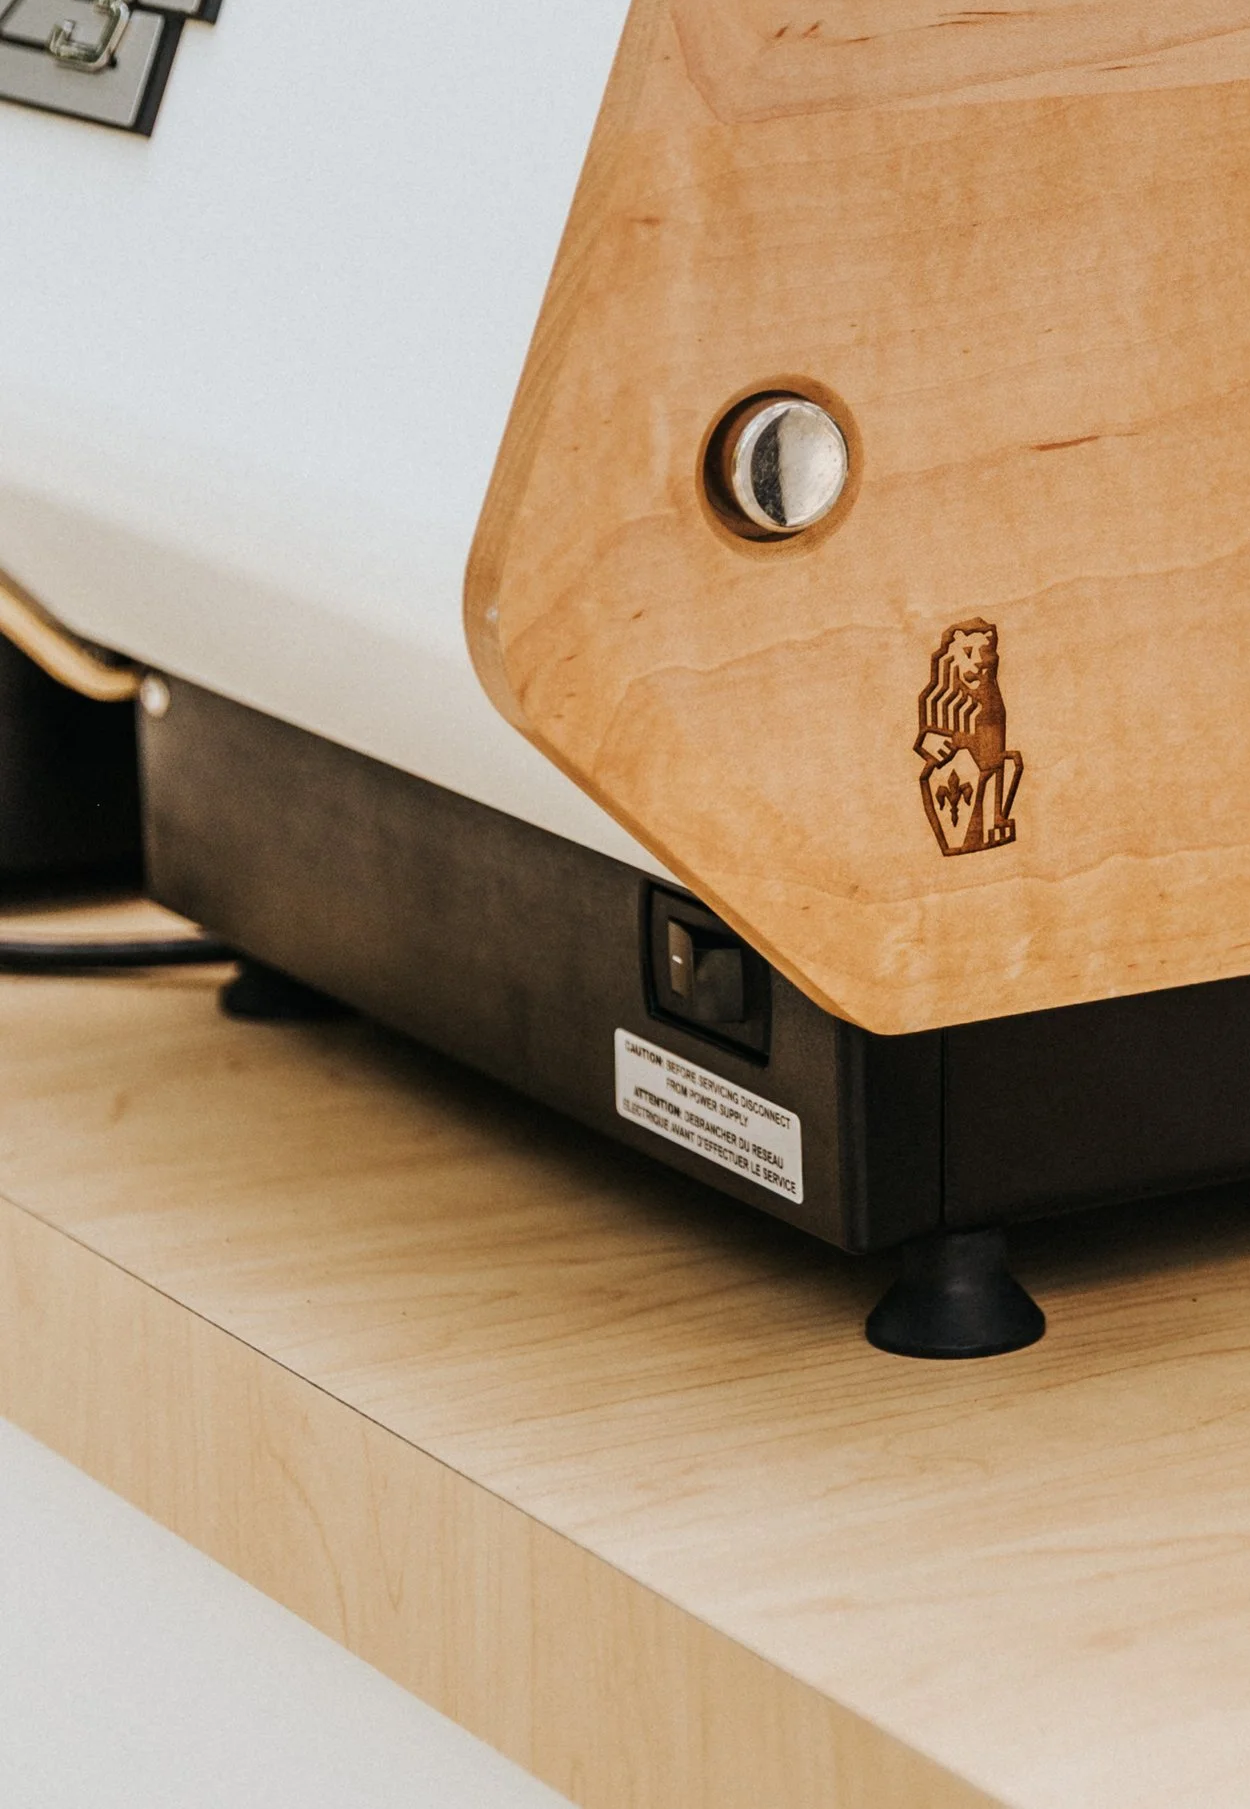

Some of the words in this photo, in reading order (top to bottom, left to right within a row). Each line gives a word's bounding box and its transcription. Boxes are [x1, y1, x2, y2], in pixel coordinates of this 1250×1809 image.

[666, 1059, 696, 1083] BEFORE
[699, 1075, 739, 1104] SERVICING
[741, 1094, 791, 1129] DISCONNECT
[666, 1078, 687, 1098] FROM
[689, 1089, 718, 1111] POWER
[720, 1104, 749, 1127] SUPPLY
[671, 1122, 695, 1142] AVANT
[697, 1133, 749, 1170] D'EFFECTUER
[751, 1160, 761, 1177] LE
[763, 1167, 797, 1195] SERVICE
[684, 1109, 737, 1145] DEBRANCHER
[739, 1136, 750, 1153] DU
[752, 1144, 784, 1169] RESEAU
